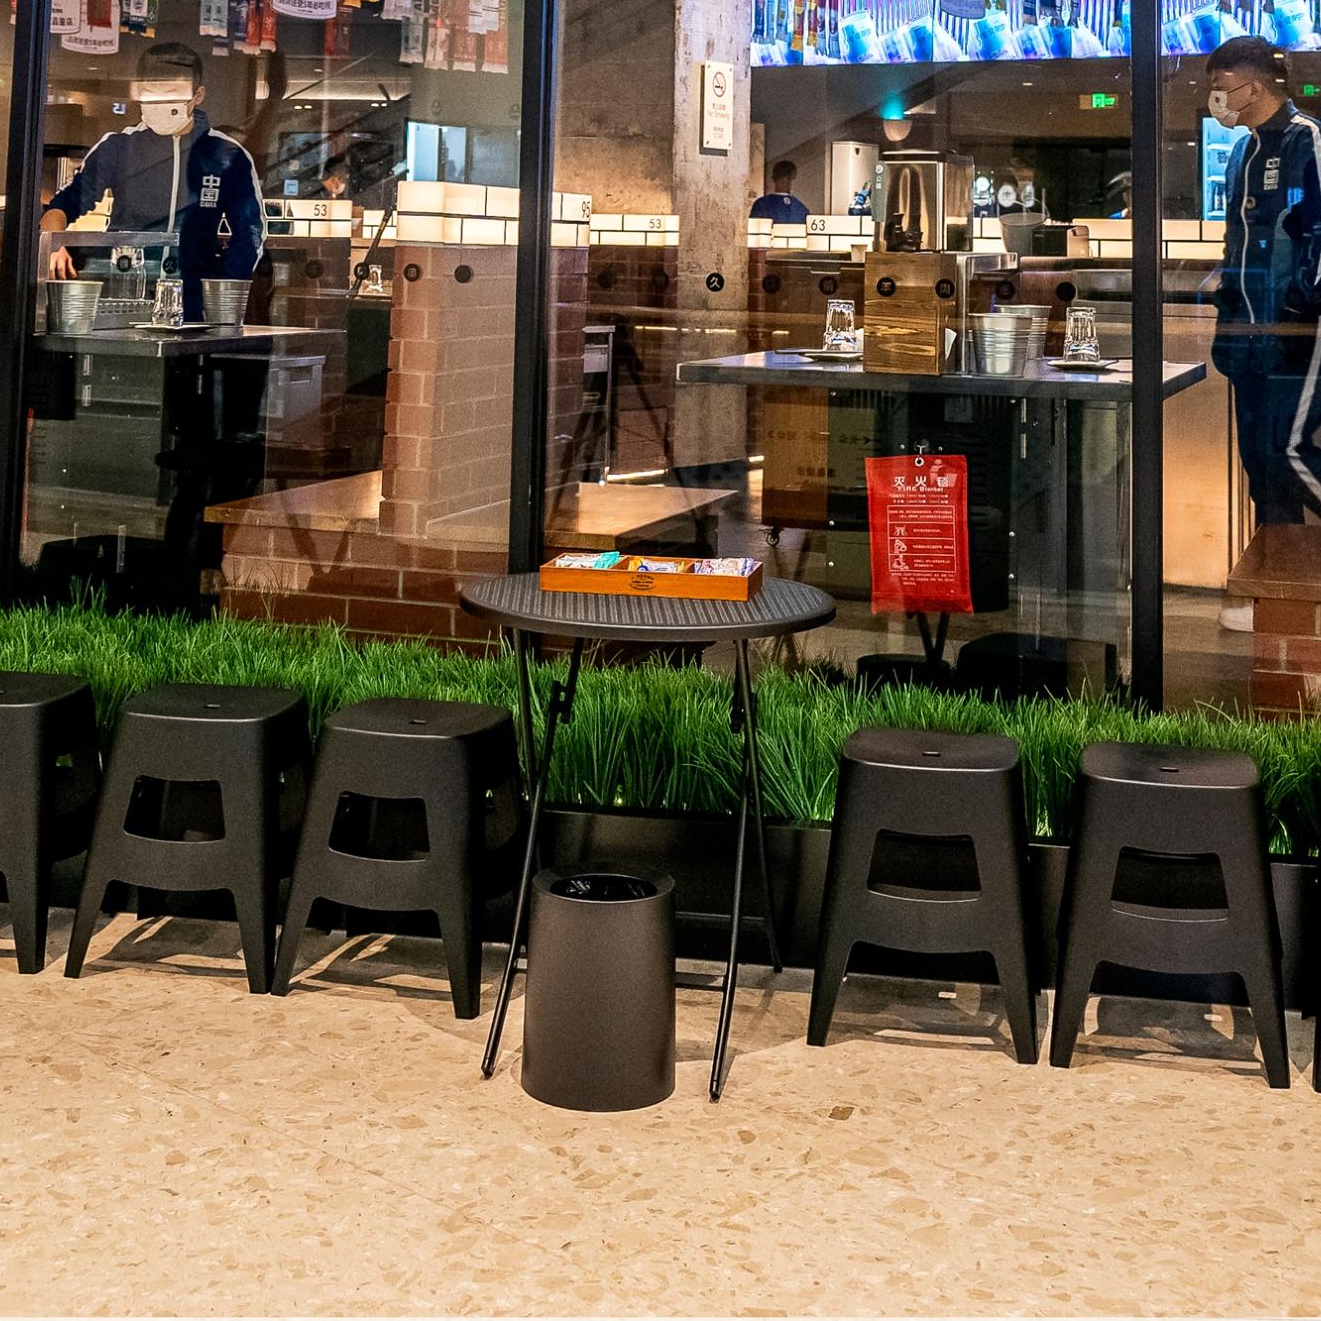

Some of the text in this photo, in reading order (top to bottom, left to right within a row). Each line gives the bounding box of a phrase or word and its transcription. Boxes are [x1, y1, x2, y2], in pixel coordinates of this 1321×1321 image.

[200, 174, 221, 202] 中国
[313, 204, 327, 217] 53
[582, 200, 592, 219] 95
[648, 218, 661, 230] 53
[810, 216, 826, 232] 63
